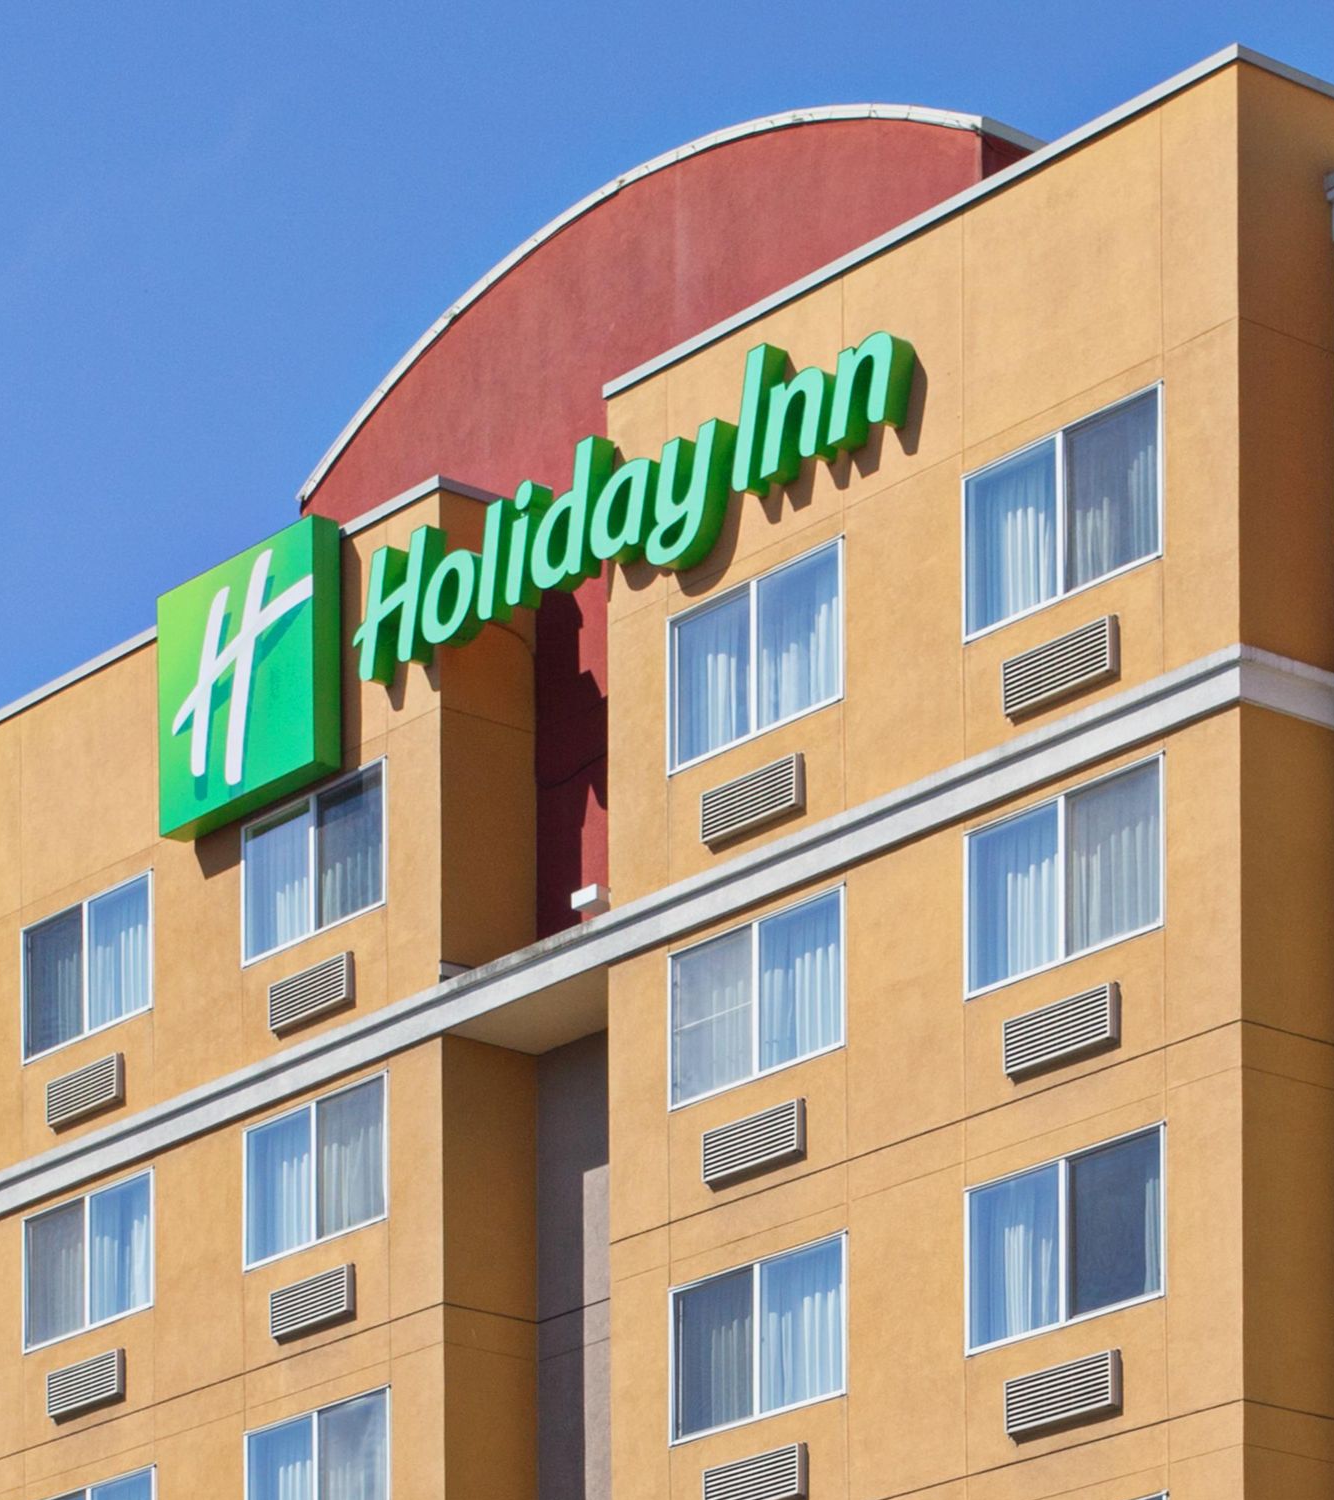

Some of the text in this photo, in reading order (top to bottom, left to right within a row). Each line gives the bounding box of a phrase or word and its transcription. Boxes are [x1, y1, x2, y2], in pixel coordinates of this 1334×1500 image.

[352, 331, 915, 686] Holiday Inn
[172, 549, 313, 785] H
